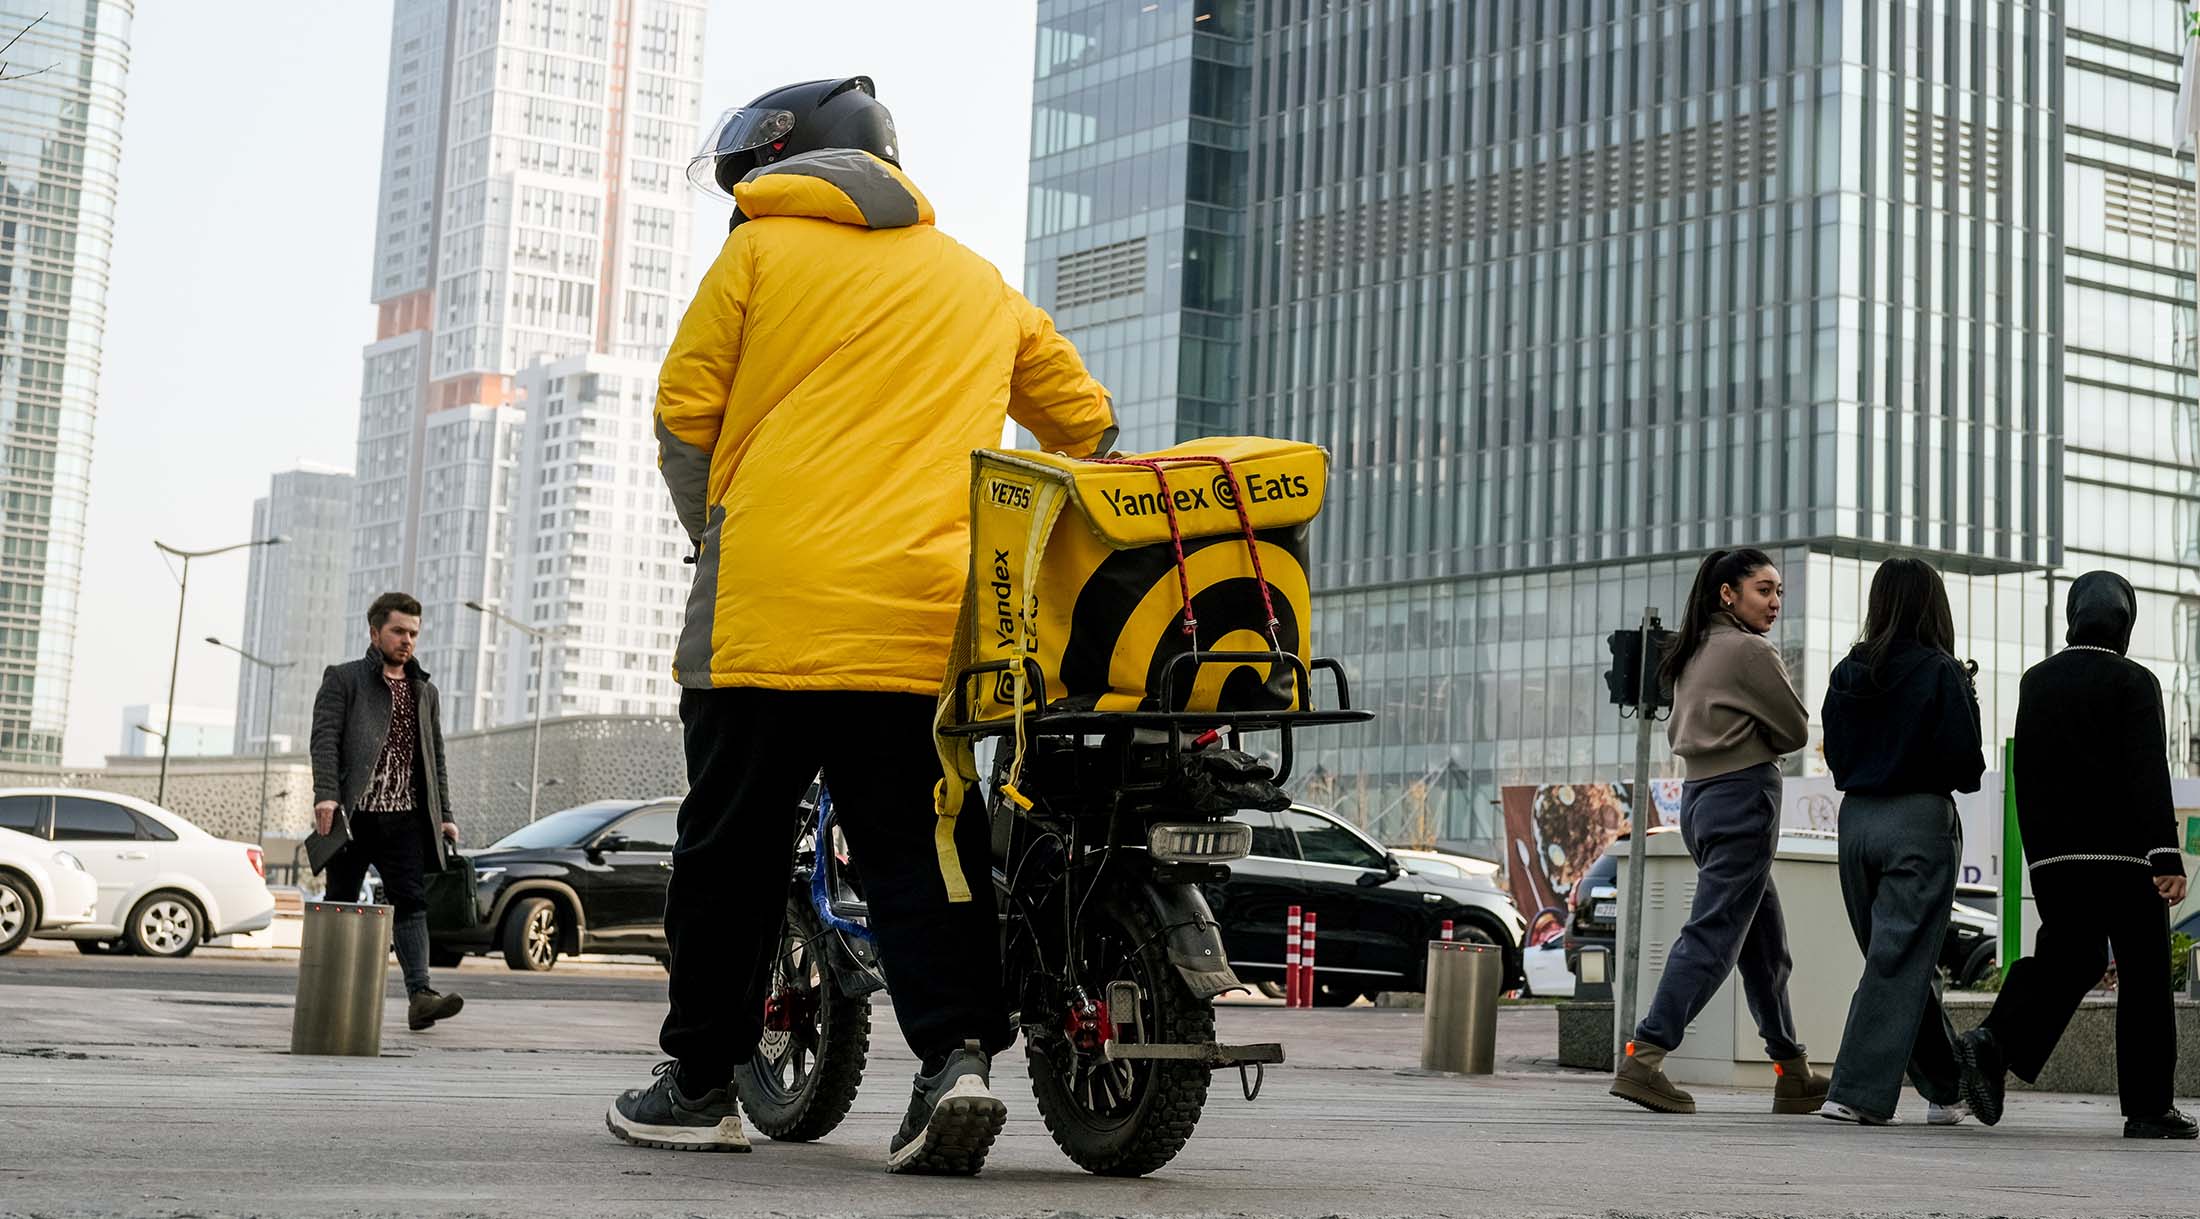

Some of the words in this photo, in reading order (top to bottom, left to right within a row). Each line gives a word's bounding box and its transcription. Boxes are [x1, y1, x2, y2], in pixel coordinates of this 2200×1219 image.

[991, 481, 1030, 508] YE755
[1245, 473, 1309, 503] Eats
[992, 549, 1014, 648] Yandex
